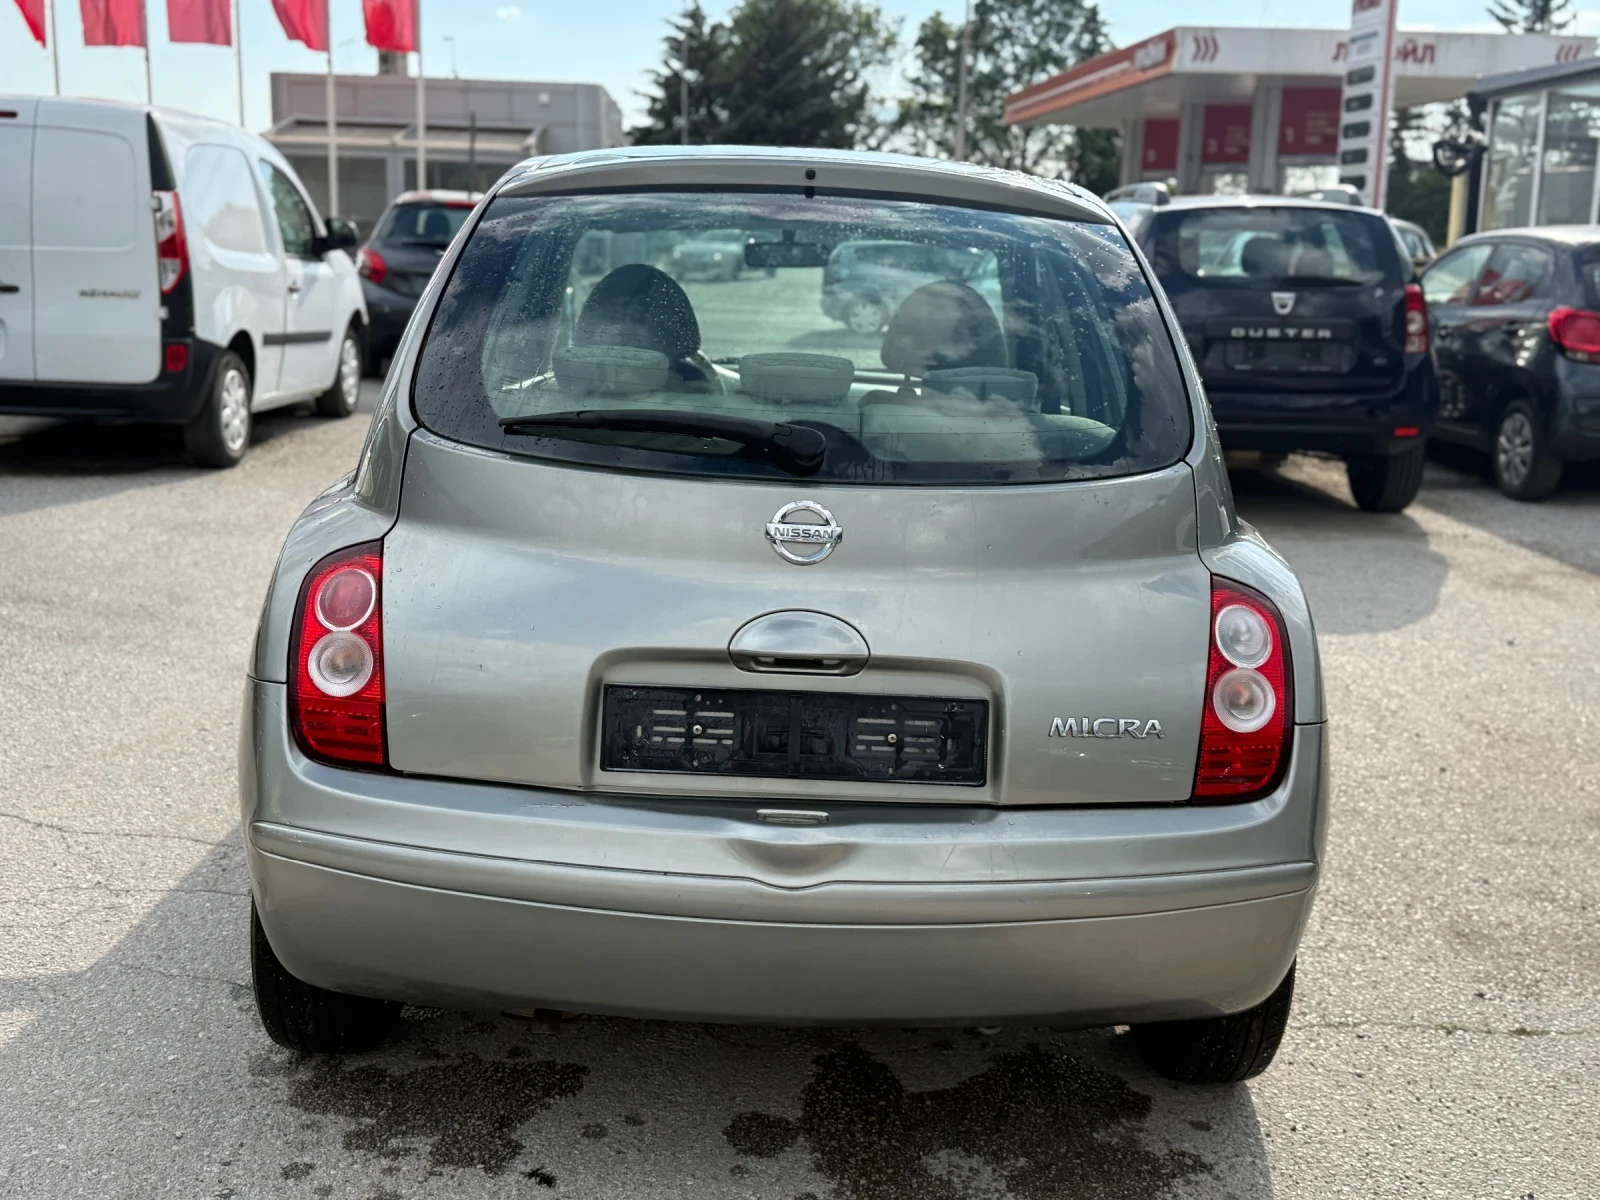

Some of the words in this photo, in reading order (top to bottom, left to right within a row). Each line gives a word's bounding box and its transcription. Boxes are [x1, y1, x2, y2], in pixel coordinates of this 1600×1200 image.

[1230, 327, 1332, 339] DUSTER
[774, 527, 834, 539] NISSAN
[1049, 716, 1165, 739] MICRA
